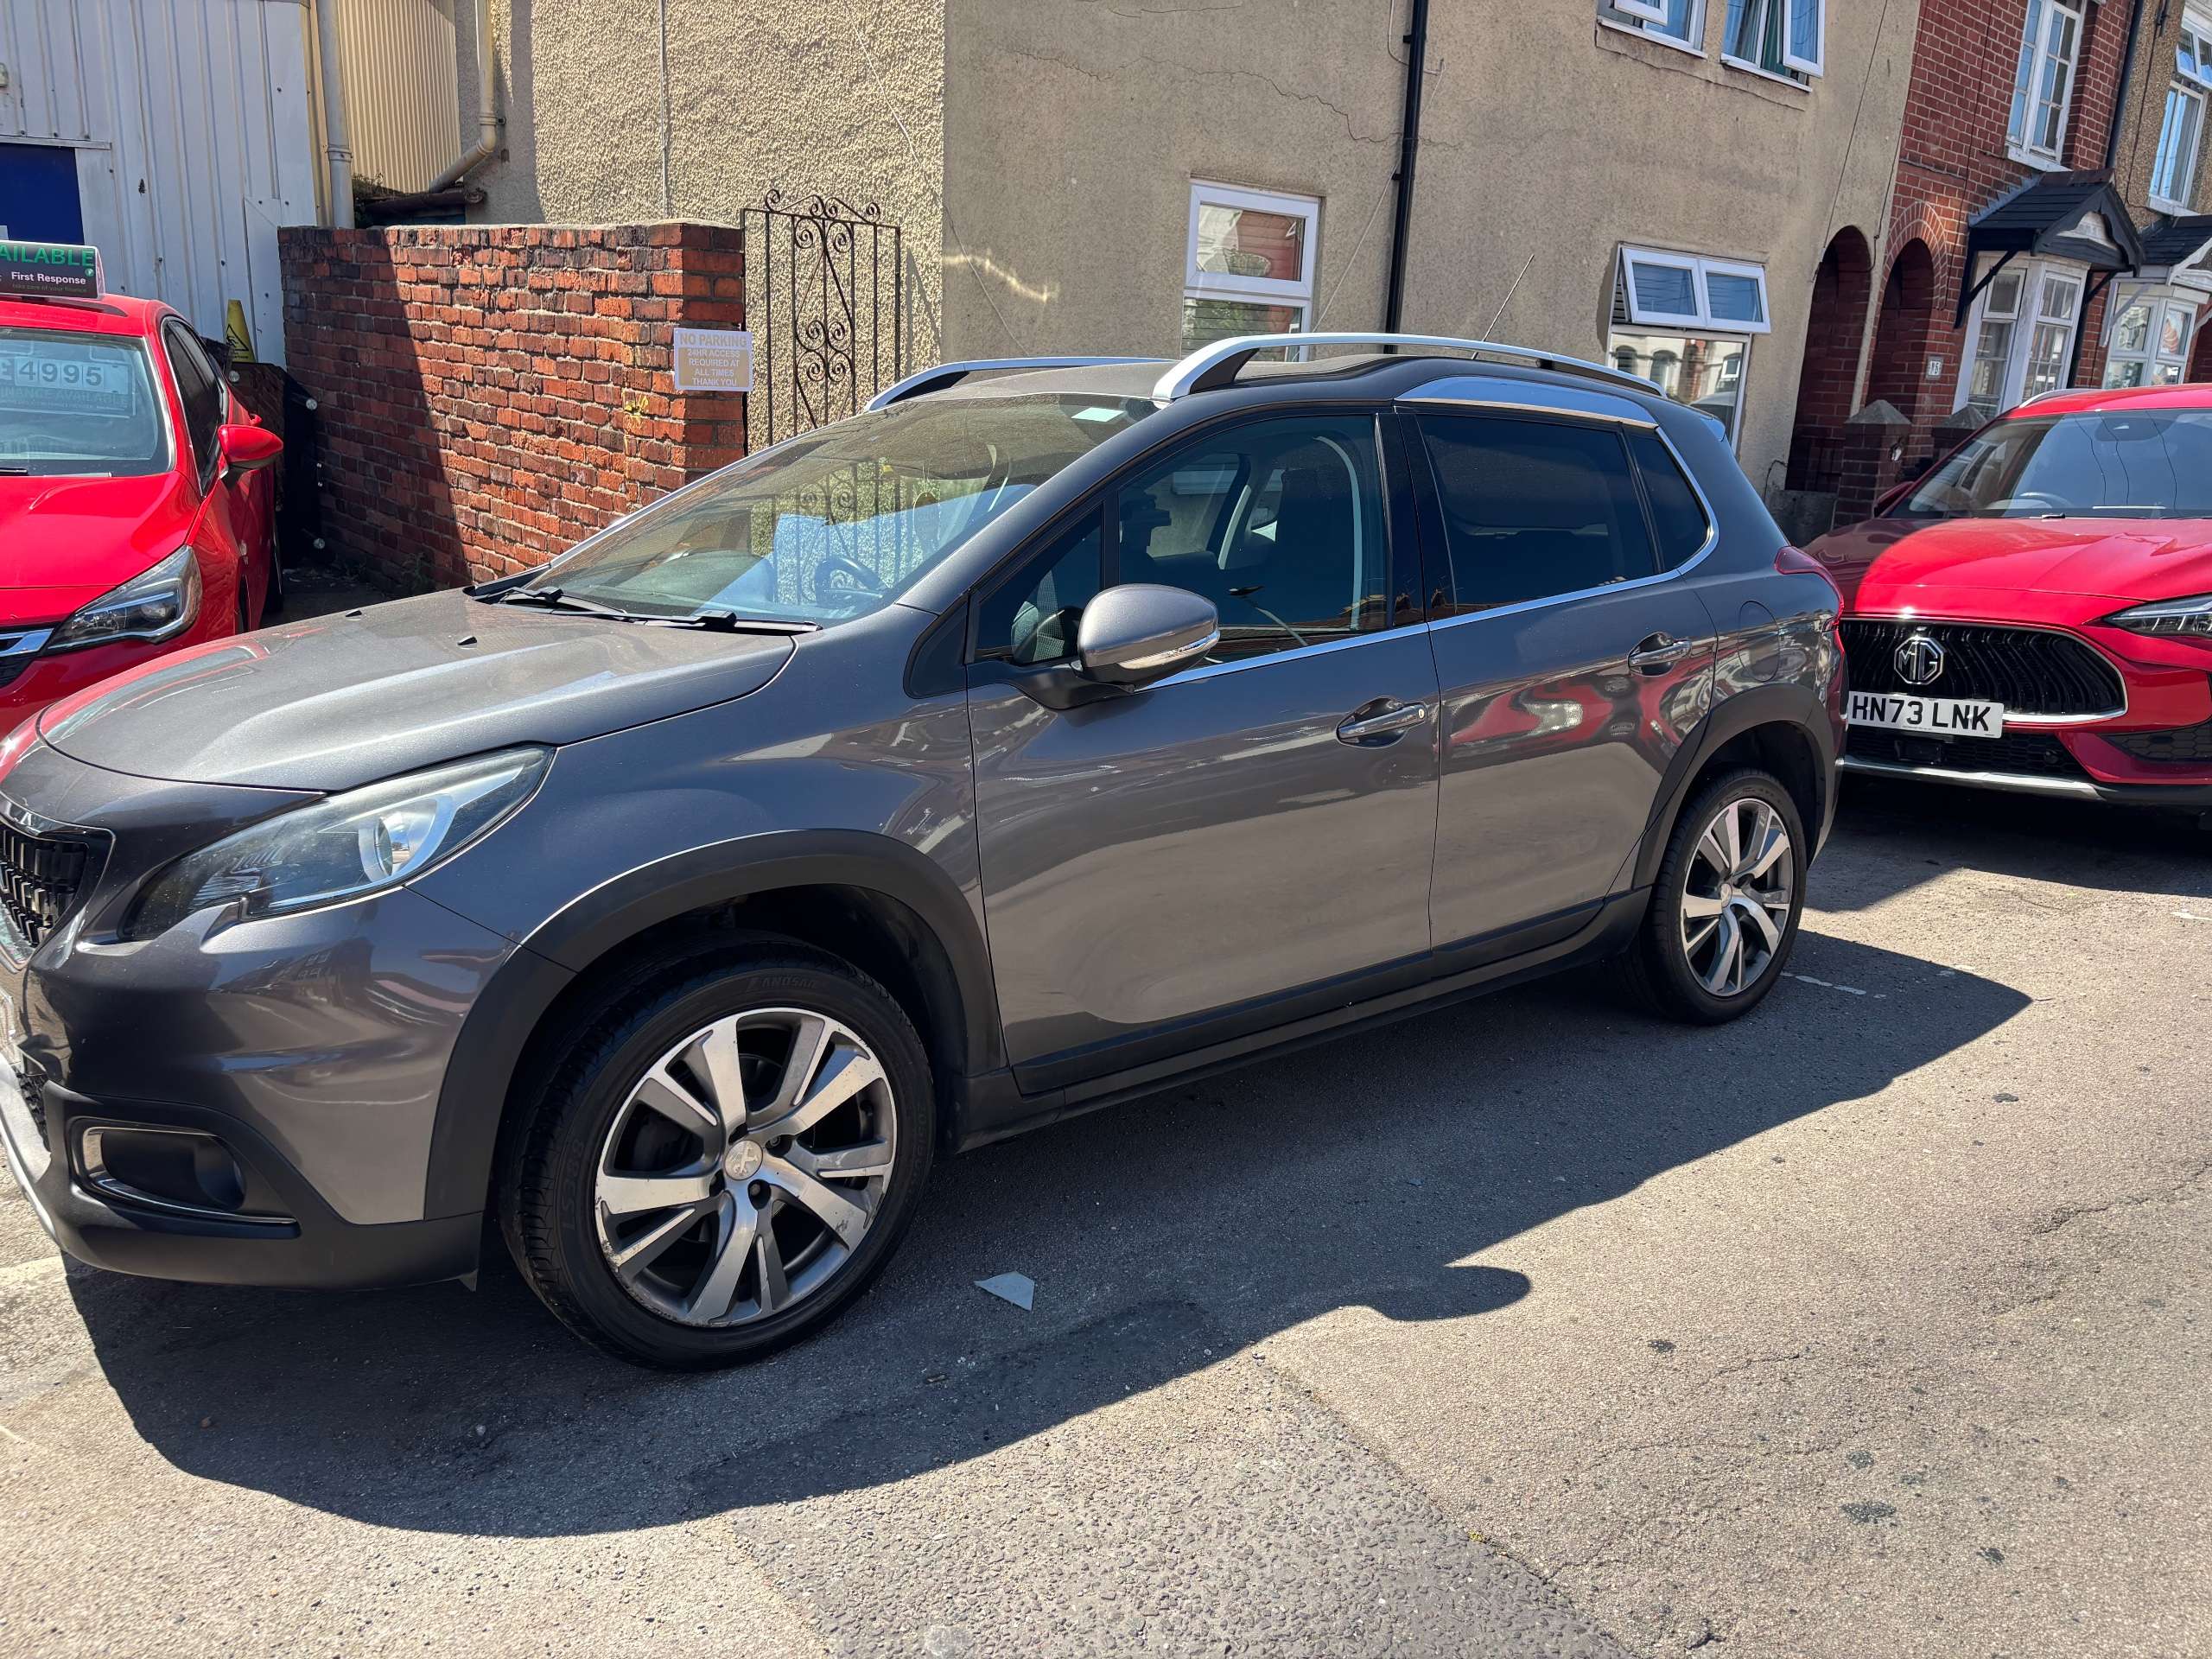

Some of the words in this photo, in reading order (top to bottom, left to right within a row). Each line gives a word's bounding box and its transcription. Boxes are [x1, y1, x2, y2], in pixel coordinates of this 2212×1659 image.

[11, 271, 35, 282] First
[37, 273, 86, 285] Response
[679, 333, 696, 345] NO
[699, 334, 747, 346] PARKING
[709, 349, 741, 358] ACCESS
[689, 359, 729, 367] REQUIRED
[712, 369, 734, 378] TIMES
[1899, 641, 1938, 681] MG
[1852, 696, 1923, 725] HN73
[1931, 702, 1991, 732] LNK
